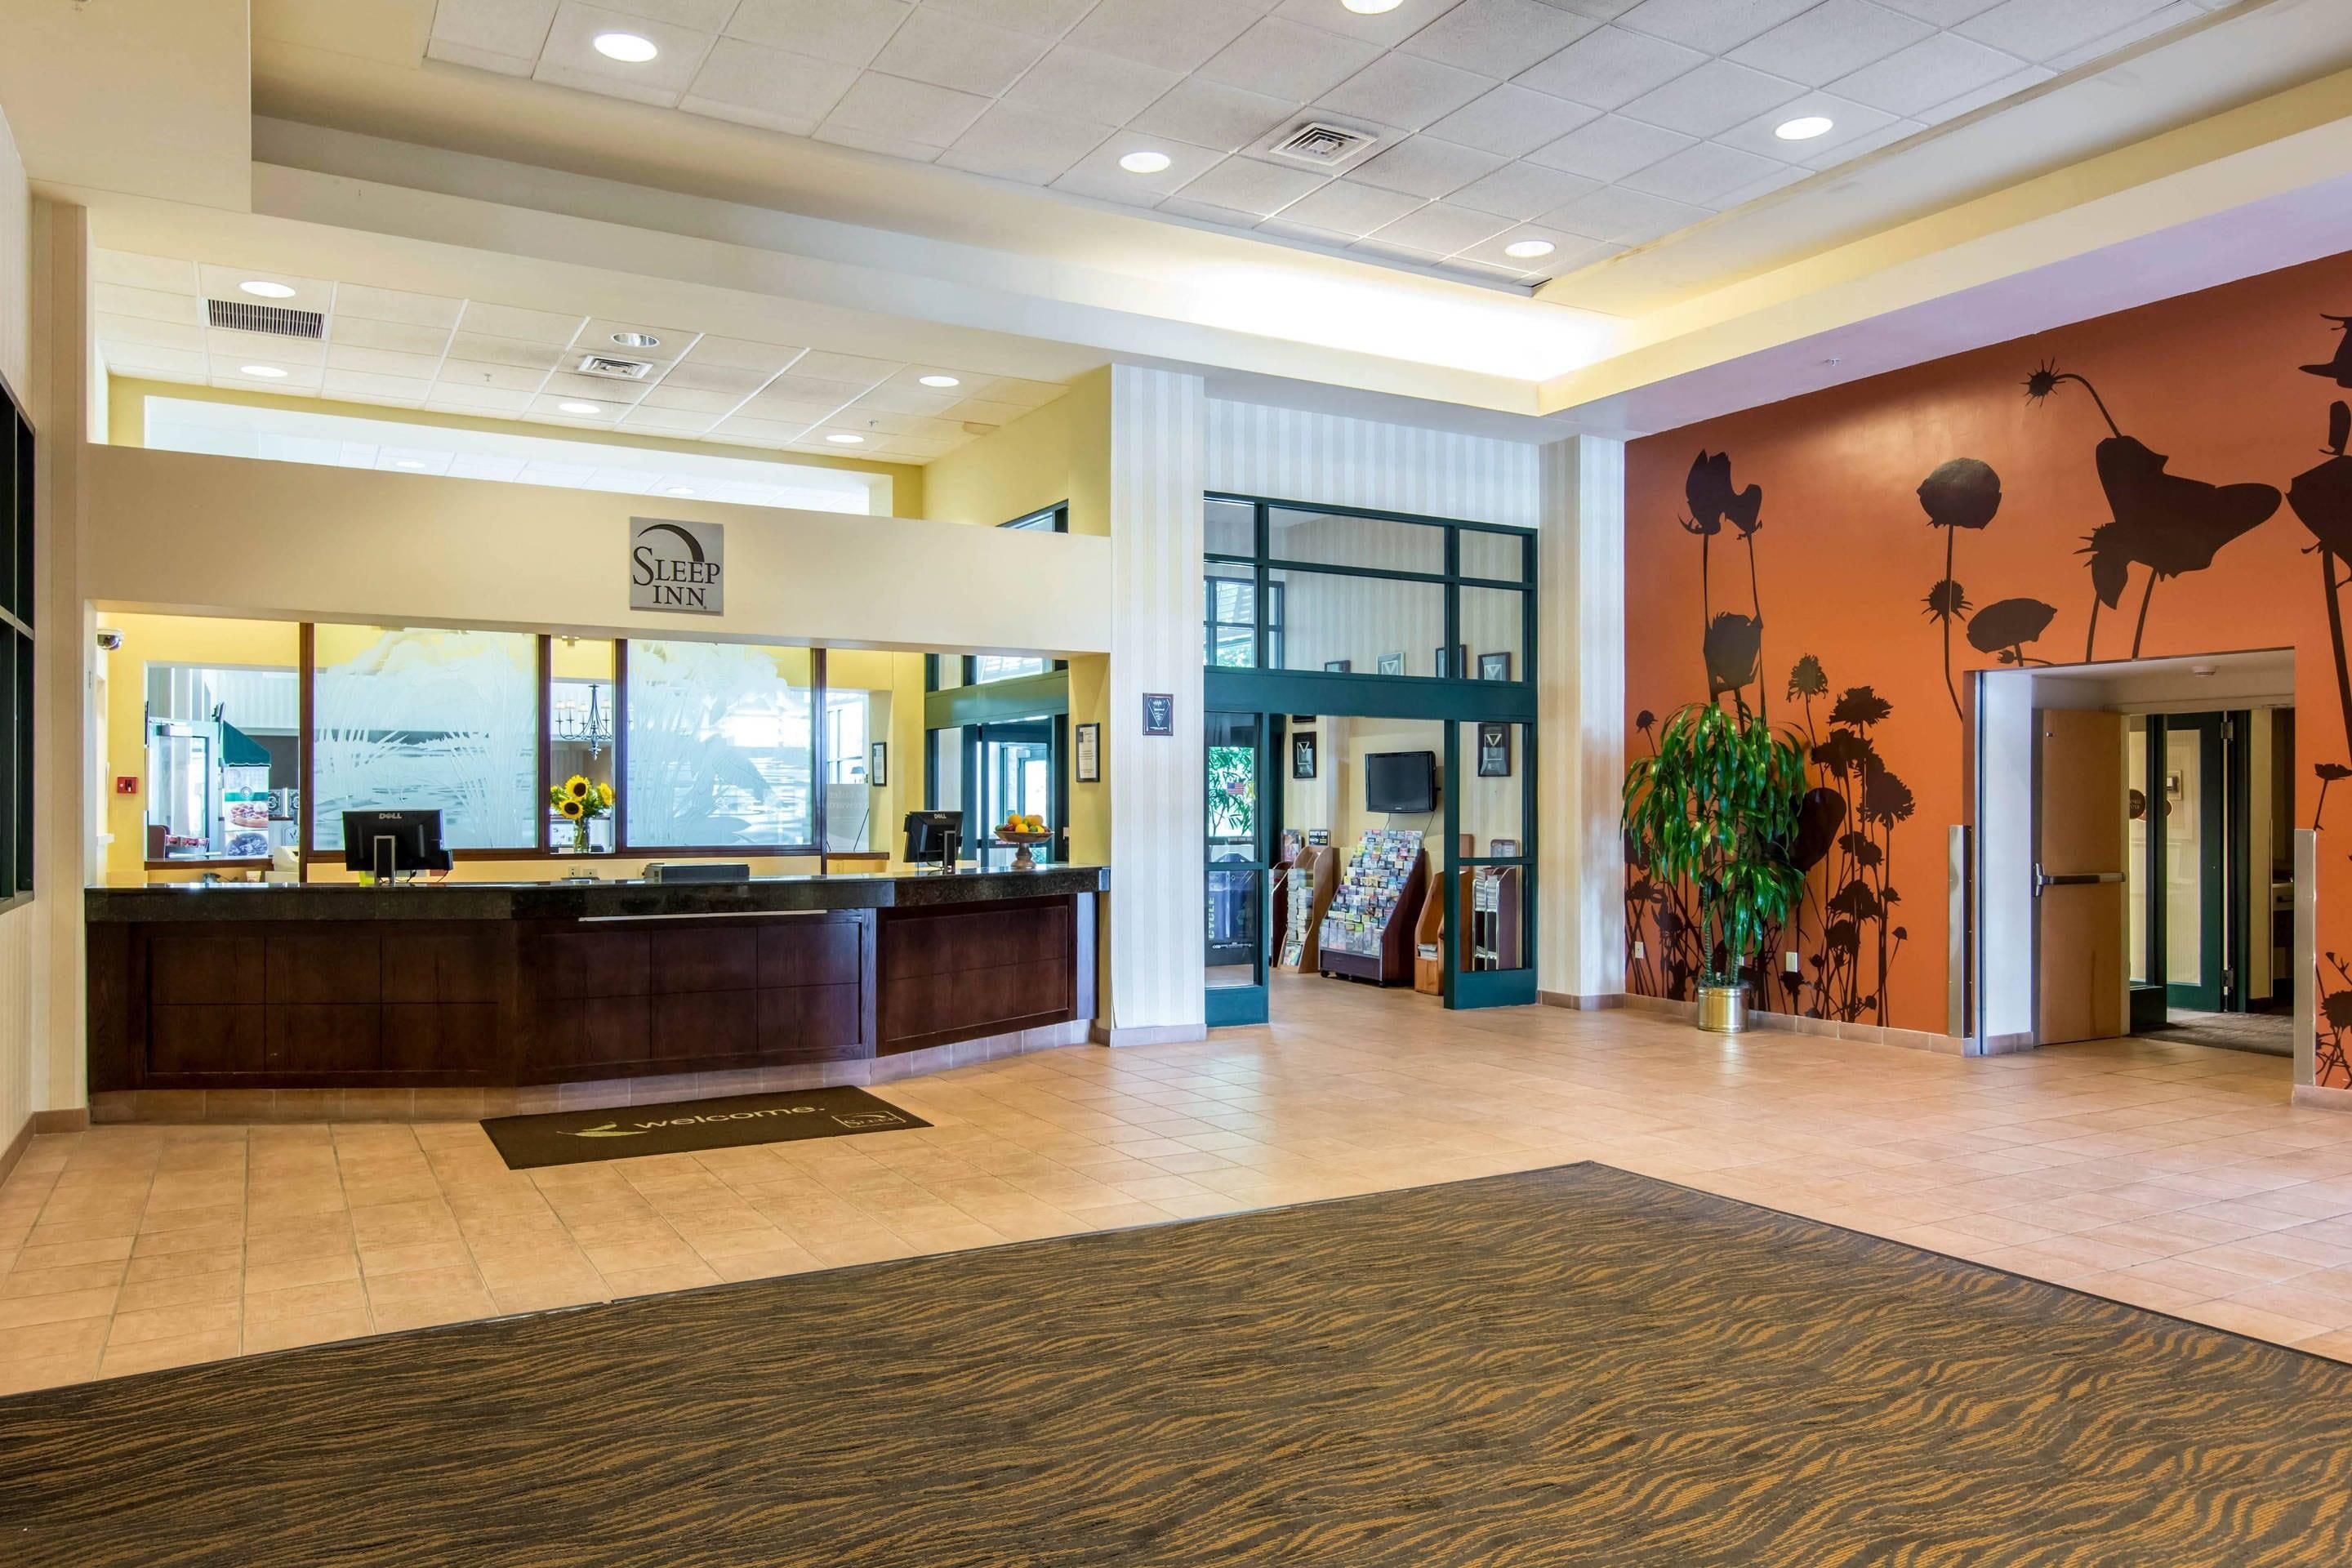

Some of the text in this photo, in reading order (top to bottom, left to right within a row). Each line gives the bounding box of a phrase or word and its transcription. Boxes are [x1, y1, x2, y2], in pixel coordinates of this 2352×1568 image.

[633, 546, 720, 586] SLEEP
[653, 585, 706, 606] INN
[378, 812, 403, 820] DELL
[634, 1107, 826, 1129] welcome.
